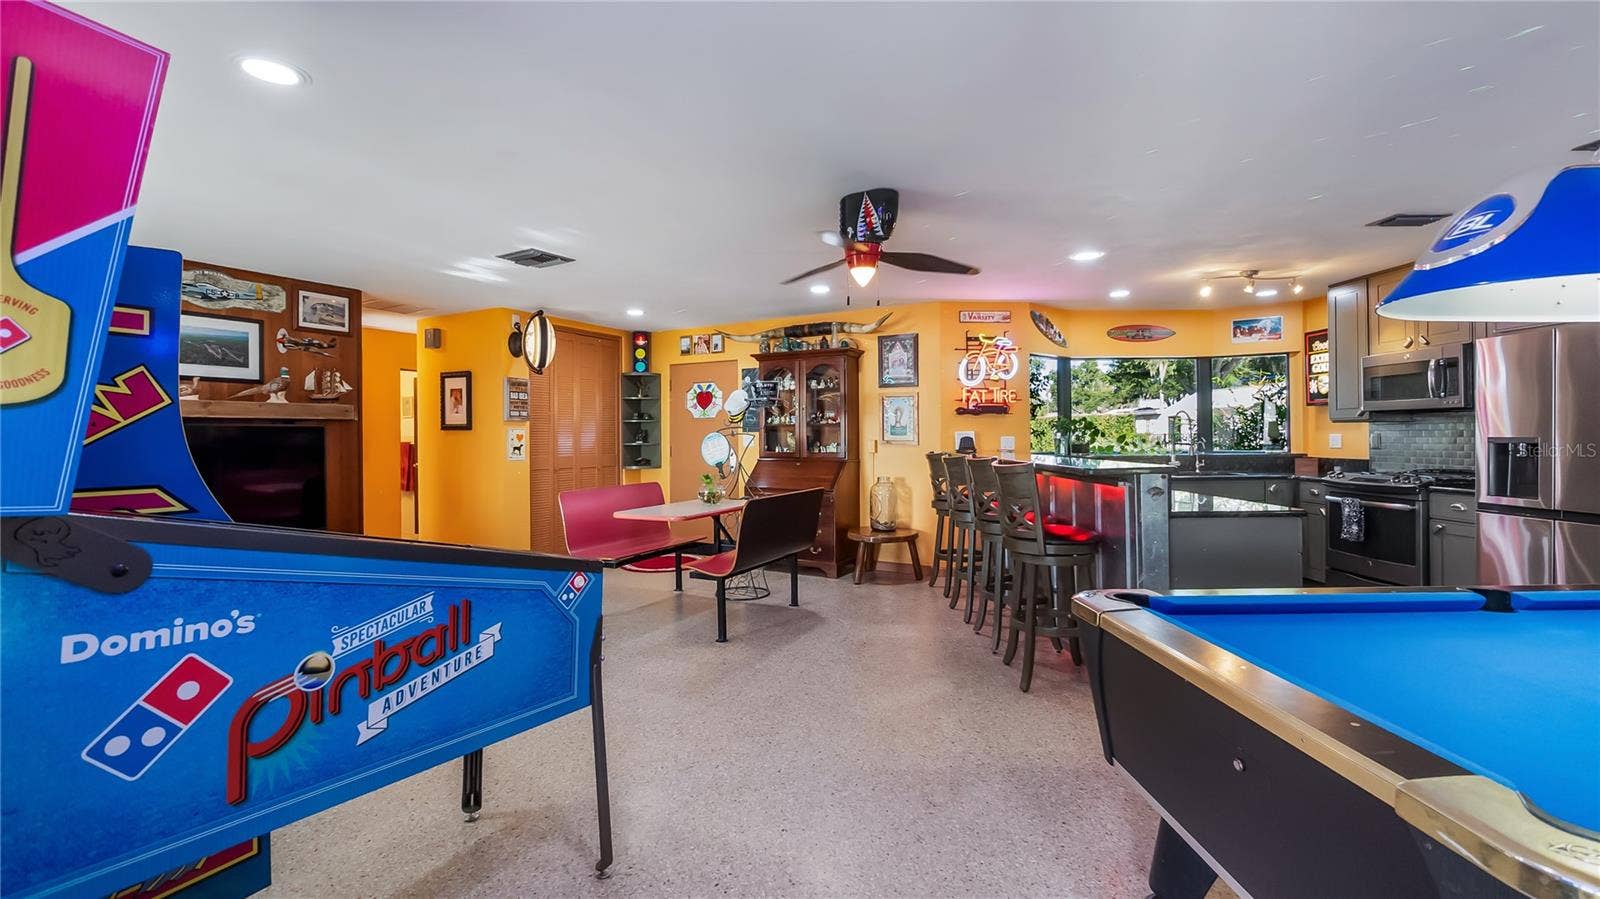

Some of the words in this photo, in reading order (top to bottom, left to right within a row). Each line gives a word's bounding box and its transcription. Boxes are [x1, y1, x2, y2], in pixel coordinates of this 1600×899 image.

[962, 387, 988, 403] FAT
[989, 387, 1017, 403] TIRE
[60, 609, 256, 665] Domino's
[340, 600, 427, 651] SPECTACULAR
[227, 599, 471, 806] pinball
[382, 645, 482, 714] ADVENTURE
